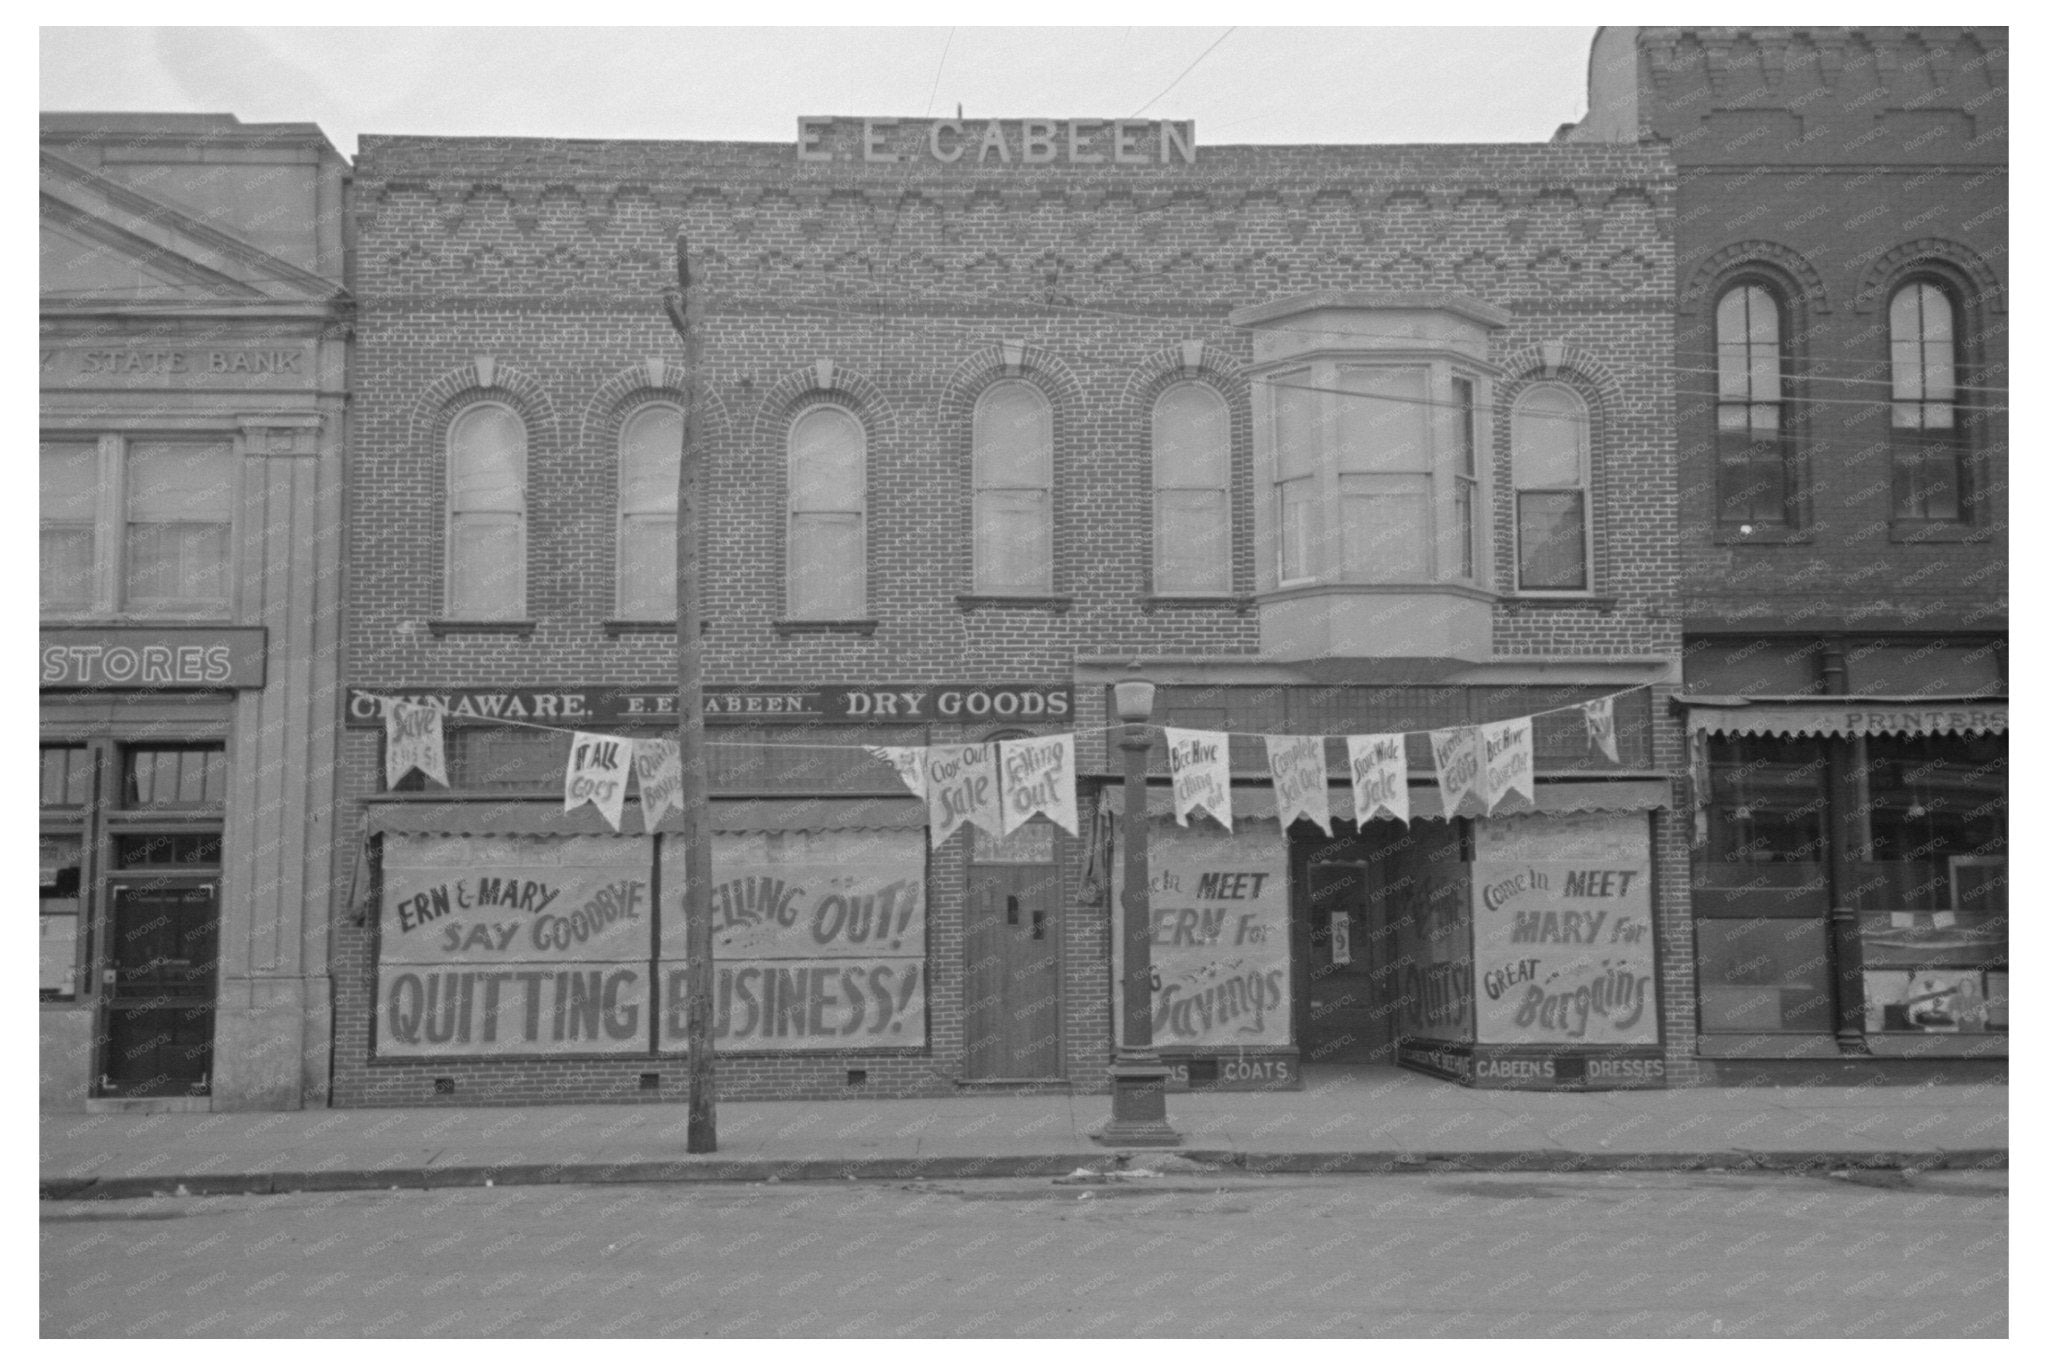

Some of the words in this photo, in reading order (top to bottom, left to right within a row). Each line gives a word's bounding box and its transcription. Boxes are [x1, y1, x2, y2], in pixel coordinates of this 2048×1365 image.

[930, 116, 1196, 164] CABEEN
[80, 352, 189, 374] STATE
[208, 352, 302, 374] BANK
[42, 645, 232, 682] STORES
[704, 698, 812, 713] ABEEN.
[846, 692, 928, 715] DRY
[937, 691, 1070, 716] GOODS
[1845, 711, 2008, 730] PRINTERS
[591, 741, 620, 771] ALL
[940, 775, 990, 830] Sale
[1196, 872, 1270, 900] MEET
[1563, 870, 1639, 898] MEET
[397, 885, 451, 934] ERN
[478, 876, 561, 915] MARY
[440, 921, 520, 952] SAY
[532, 879, 646, 951] GOODBYE
[711, 876, 806, 935] ELLING
[812, 878, 919, 950] OUT!
[1150, 907, 1227, 947] ERN
[1512, 910, 1609, 945] MARY
[1483, 958, 1541, 1001] GREAT
[388, 968, 640, 1045] QUITTING
[1150, 968, 1284, 1038] Savings
[1513, 968, 1652, 1039] Bargains
[1224, 1061, 1288, 1081] COATS
[1587, 1058, 1665, 1079] DRESSES
